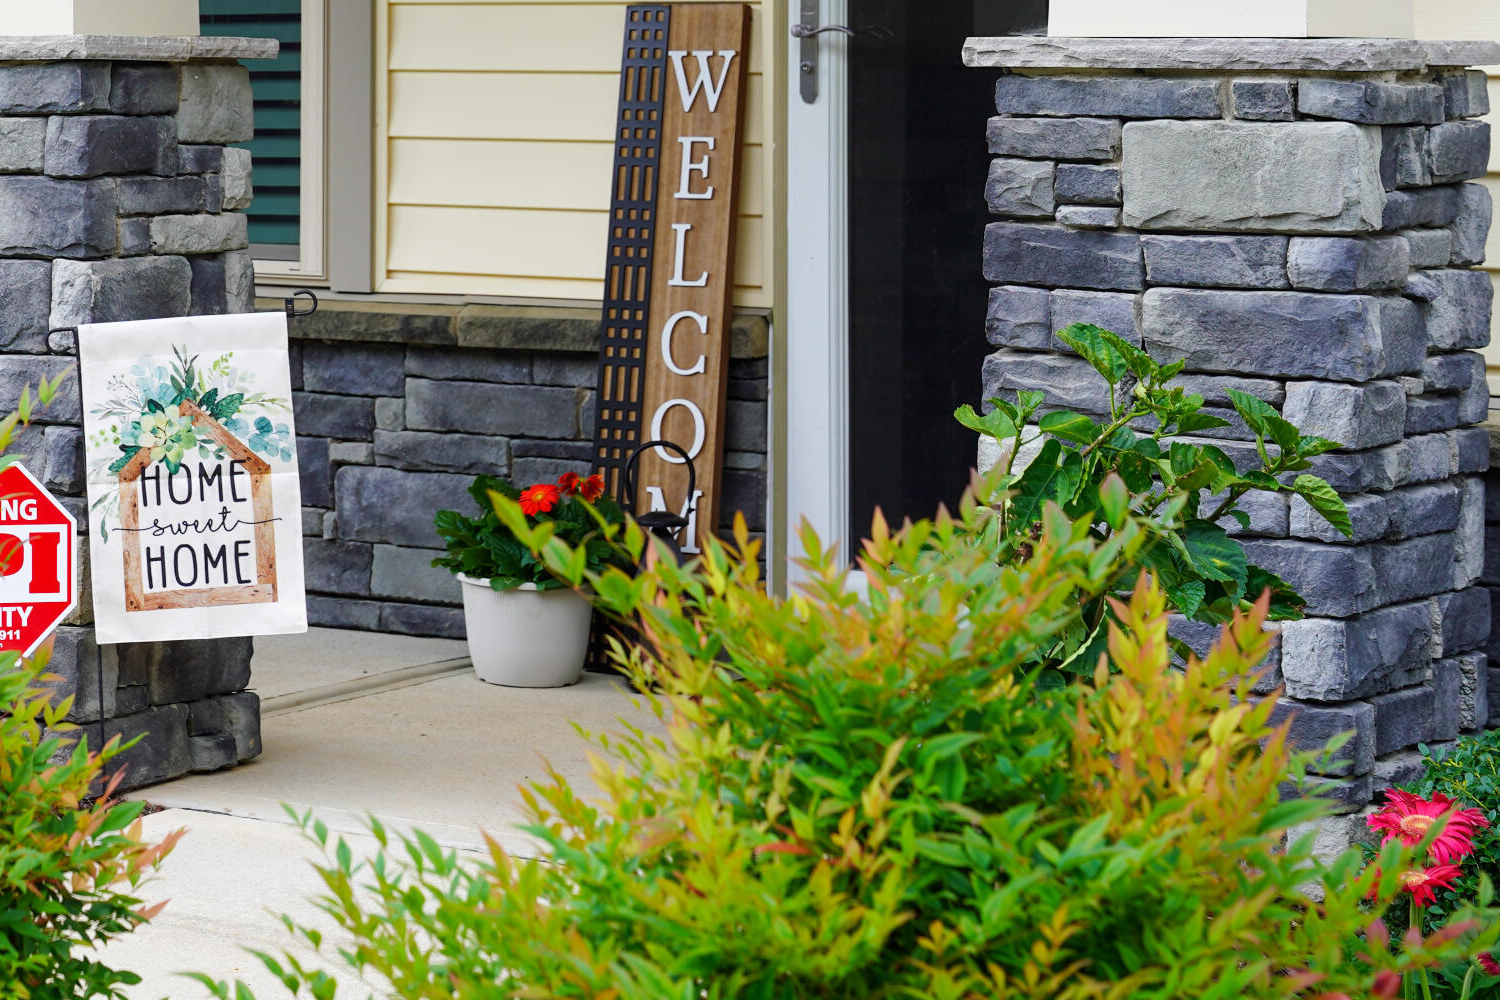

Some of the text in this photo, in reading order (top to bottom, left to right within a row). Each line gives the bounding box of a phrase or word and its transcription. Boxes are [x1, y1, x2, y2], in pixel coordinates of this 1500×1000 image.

[645, 50, 736, 554] WELCOM
[140, 459, 247, 507] HOME
[112, 506, 282, 536] sweet
[146, 540, 252, 589] HOME
